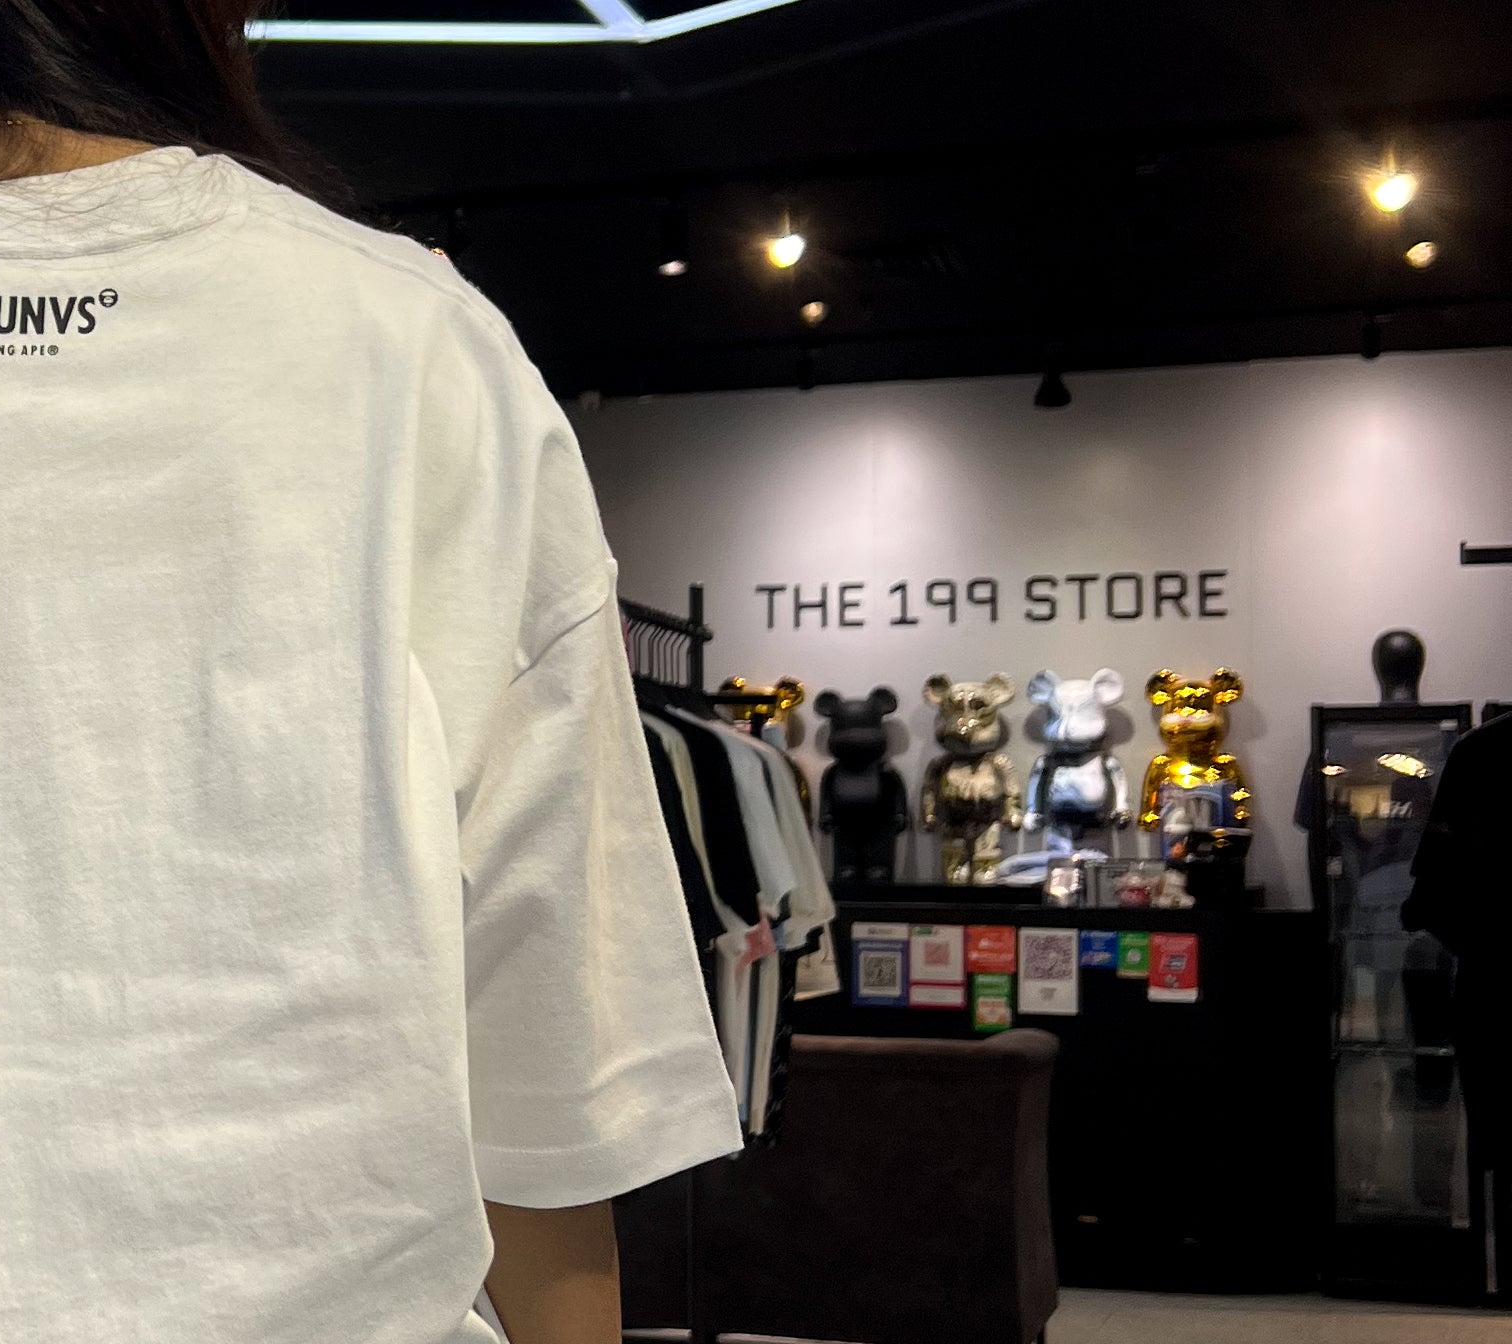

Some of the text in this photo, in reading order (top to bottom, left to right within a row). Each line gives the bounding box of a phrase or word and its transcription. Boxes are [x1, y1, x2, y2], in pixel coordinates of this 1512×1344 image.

[755, 567, 1230, 630] THE 199 STORE
